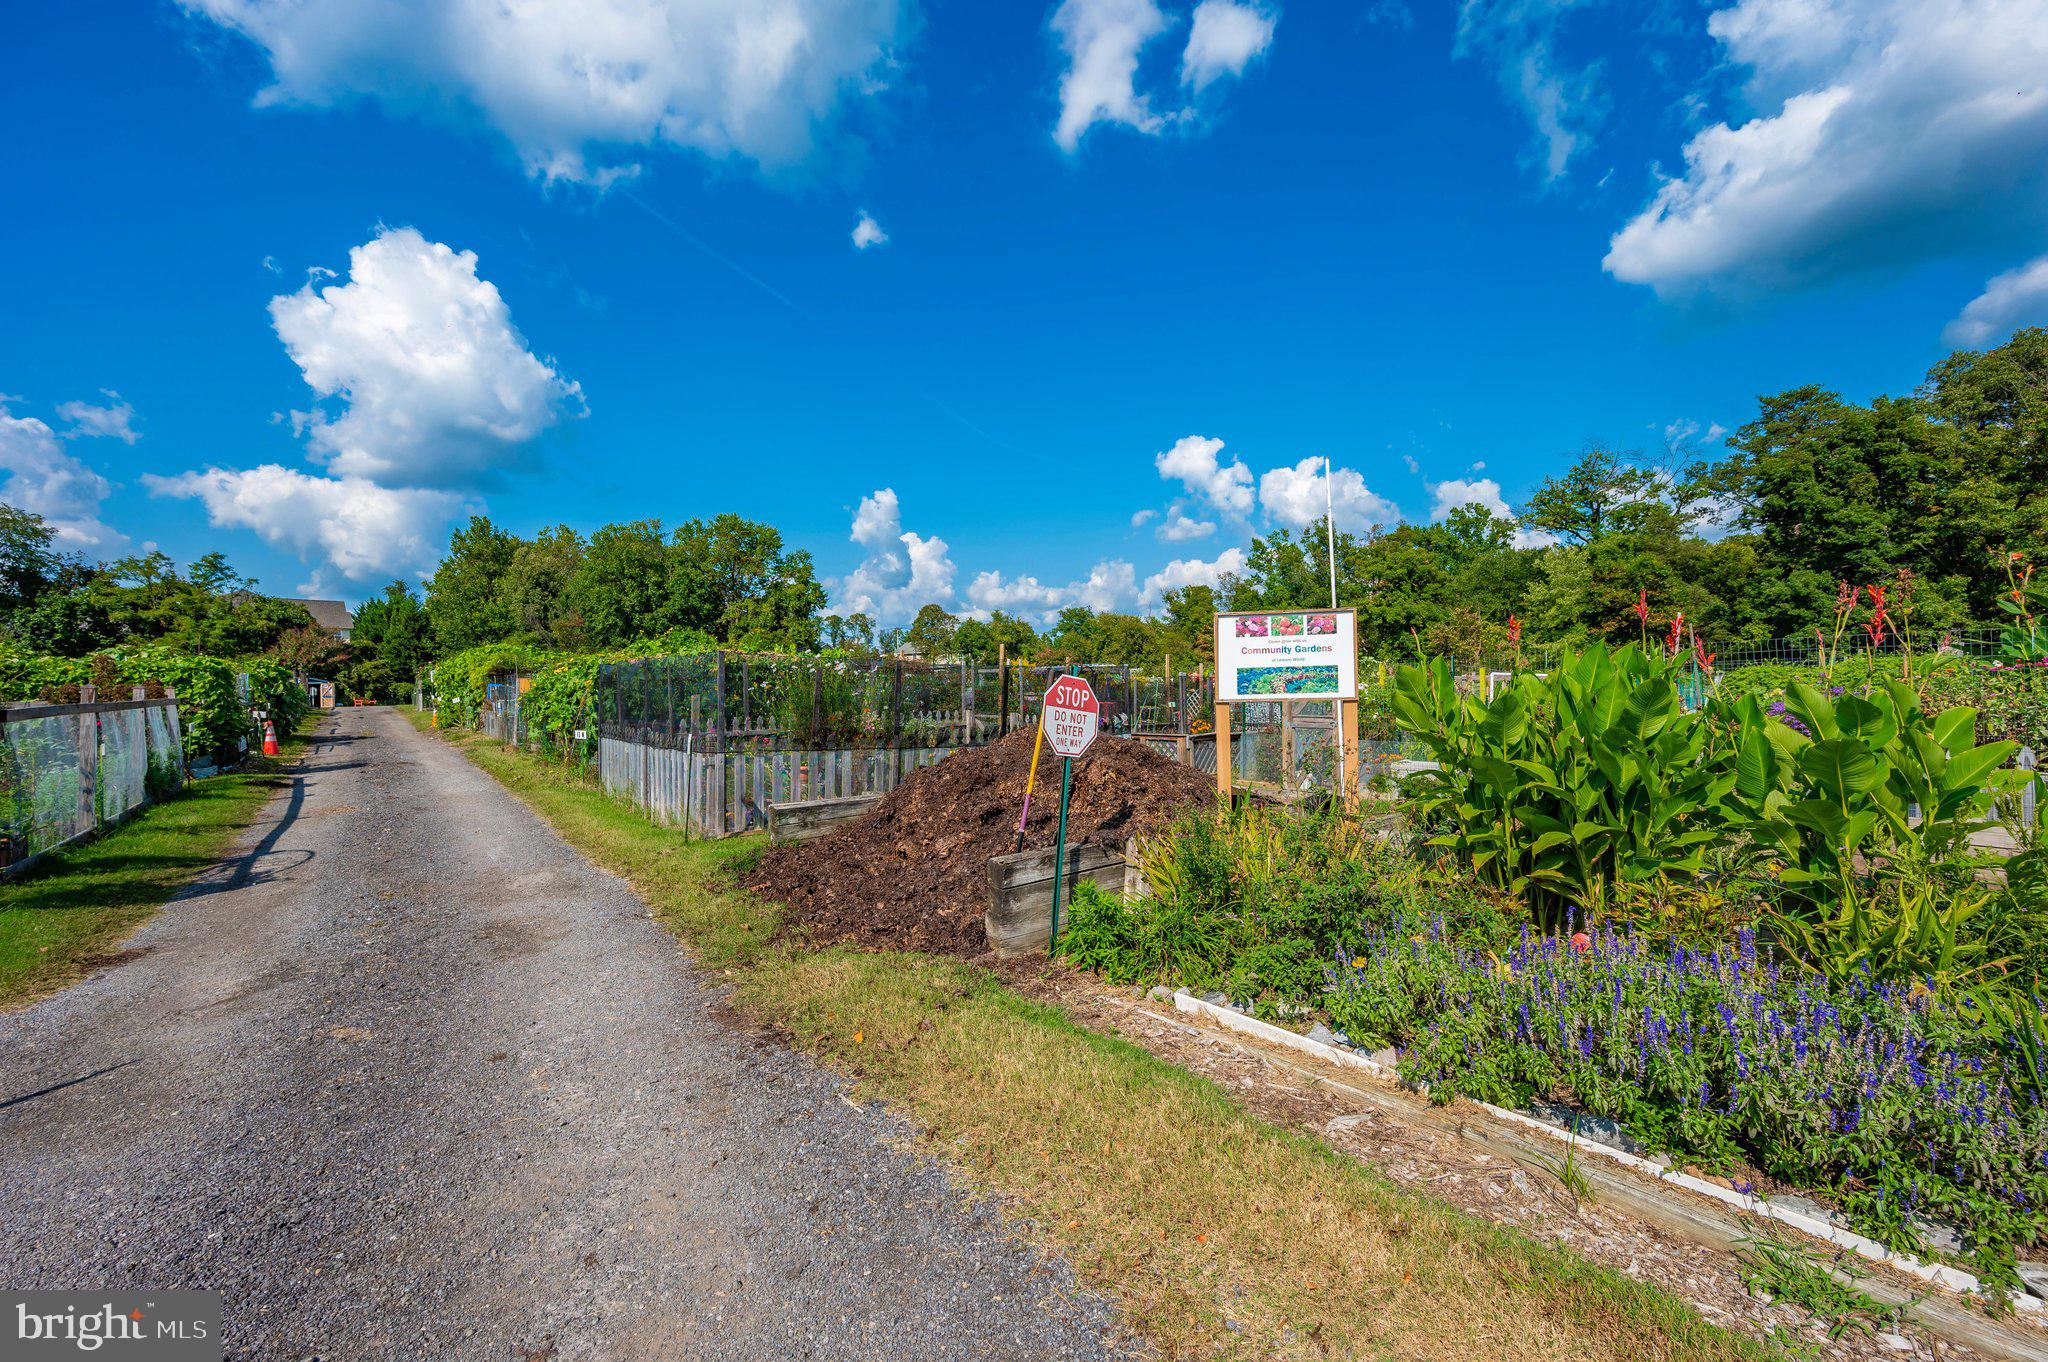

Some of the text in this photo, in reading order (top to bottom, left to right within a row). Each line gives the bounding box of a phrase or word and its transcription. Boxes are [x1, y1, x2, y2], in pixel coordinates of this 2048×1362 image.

[1241, 645, 1333, 655] Community Gardens
[1056, 685, 1090, 708] STOP
[1054, 710, 1087, 725] DO NOT
[1056, 724, 1084, 737] ENTER
[1056, 737, 1082, 748] ONE WAY
